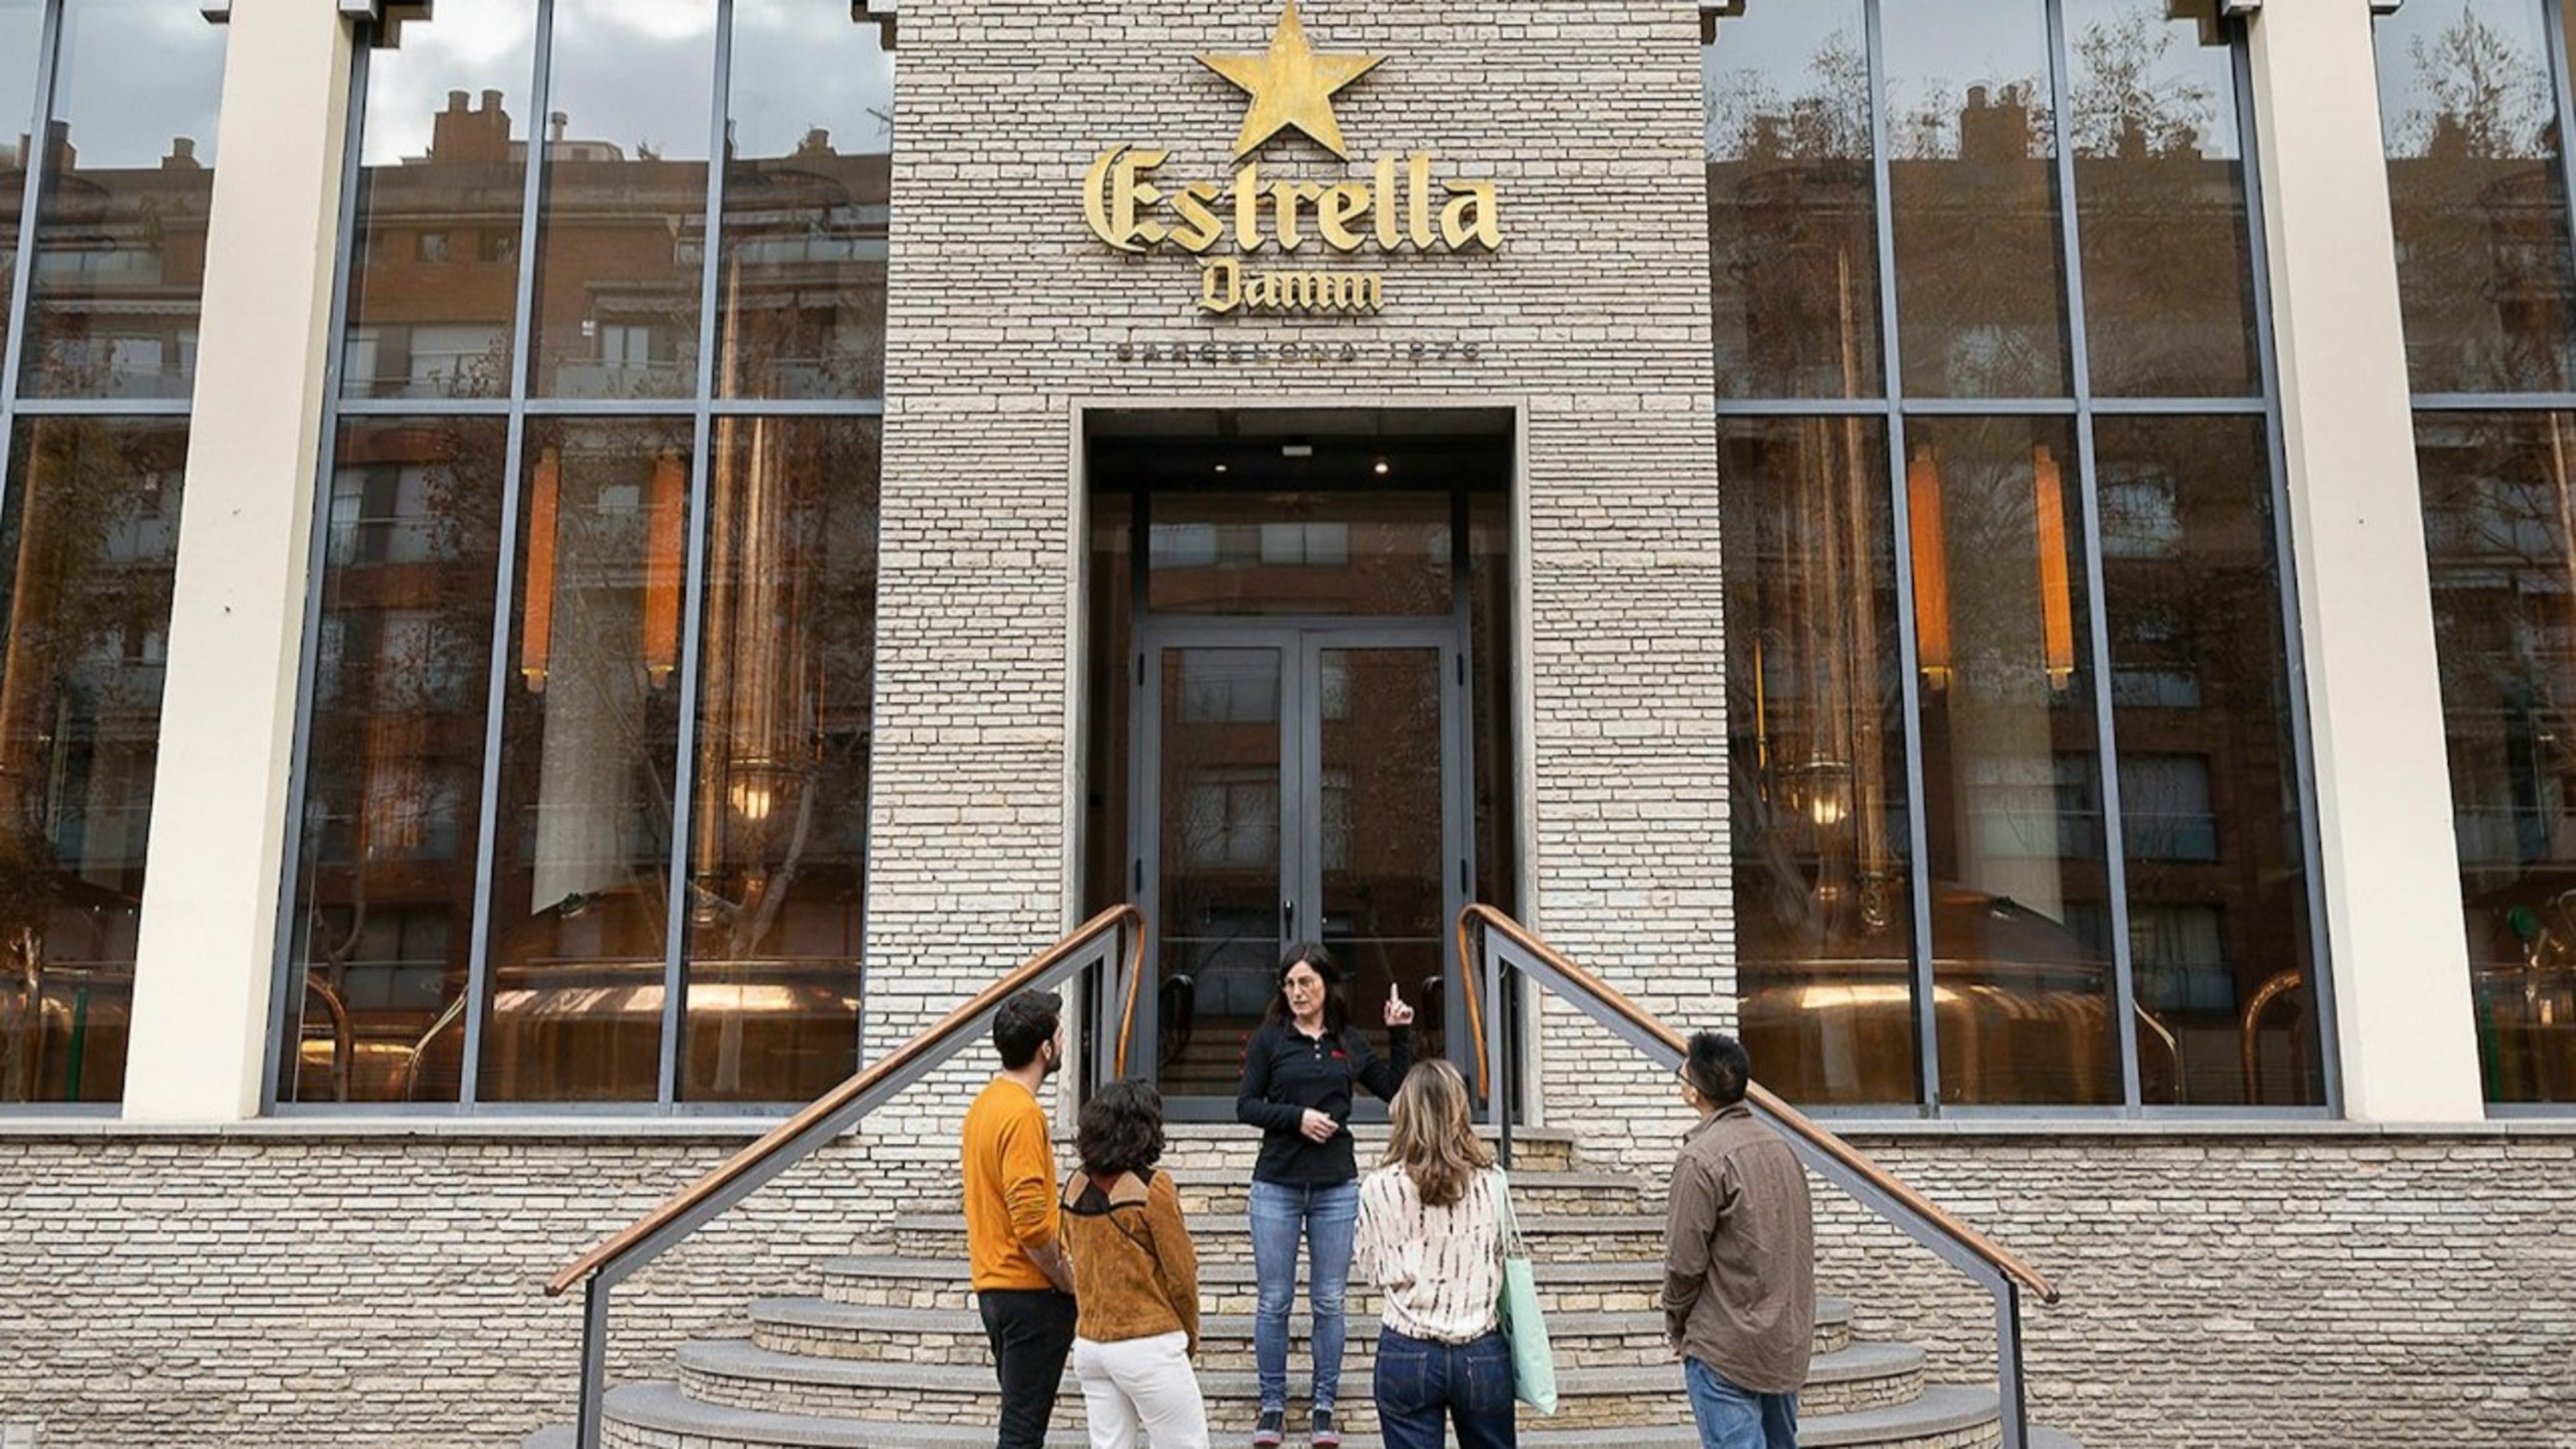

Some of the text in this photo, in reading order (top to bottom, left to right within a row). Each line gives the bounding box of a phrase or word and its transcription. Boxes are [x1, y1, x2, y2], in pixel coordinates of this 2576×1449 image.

[1083, 144, 1503, 252] Estrella
[1198, 257, 1383, 313] Damm
[1118, 344, 1357, 362] BARCELONA
